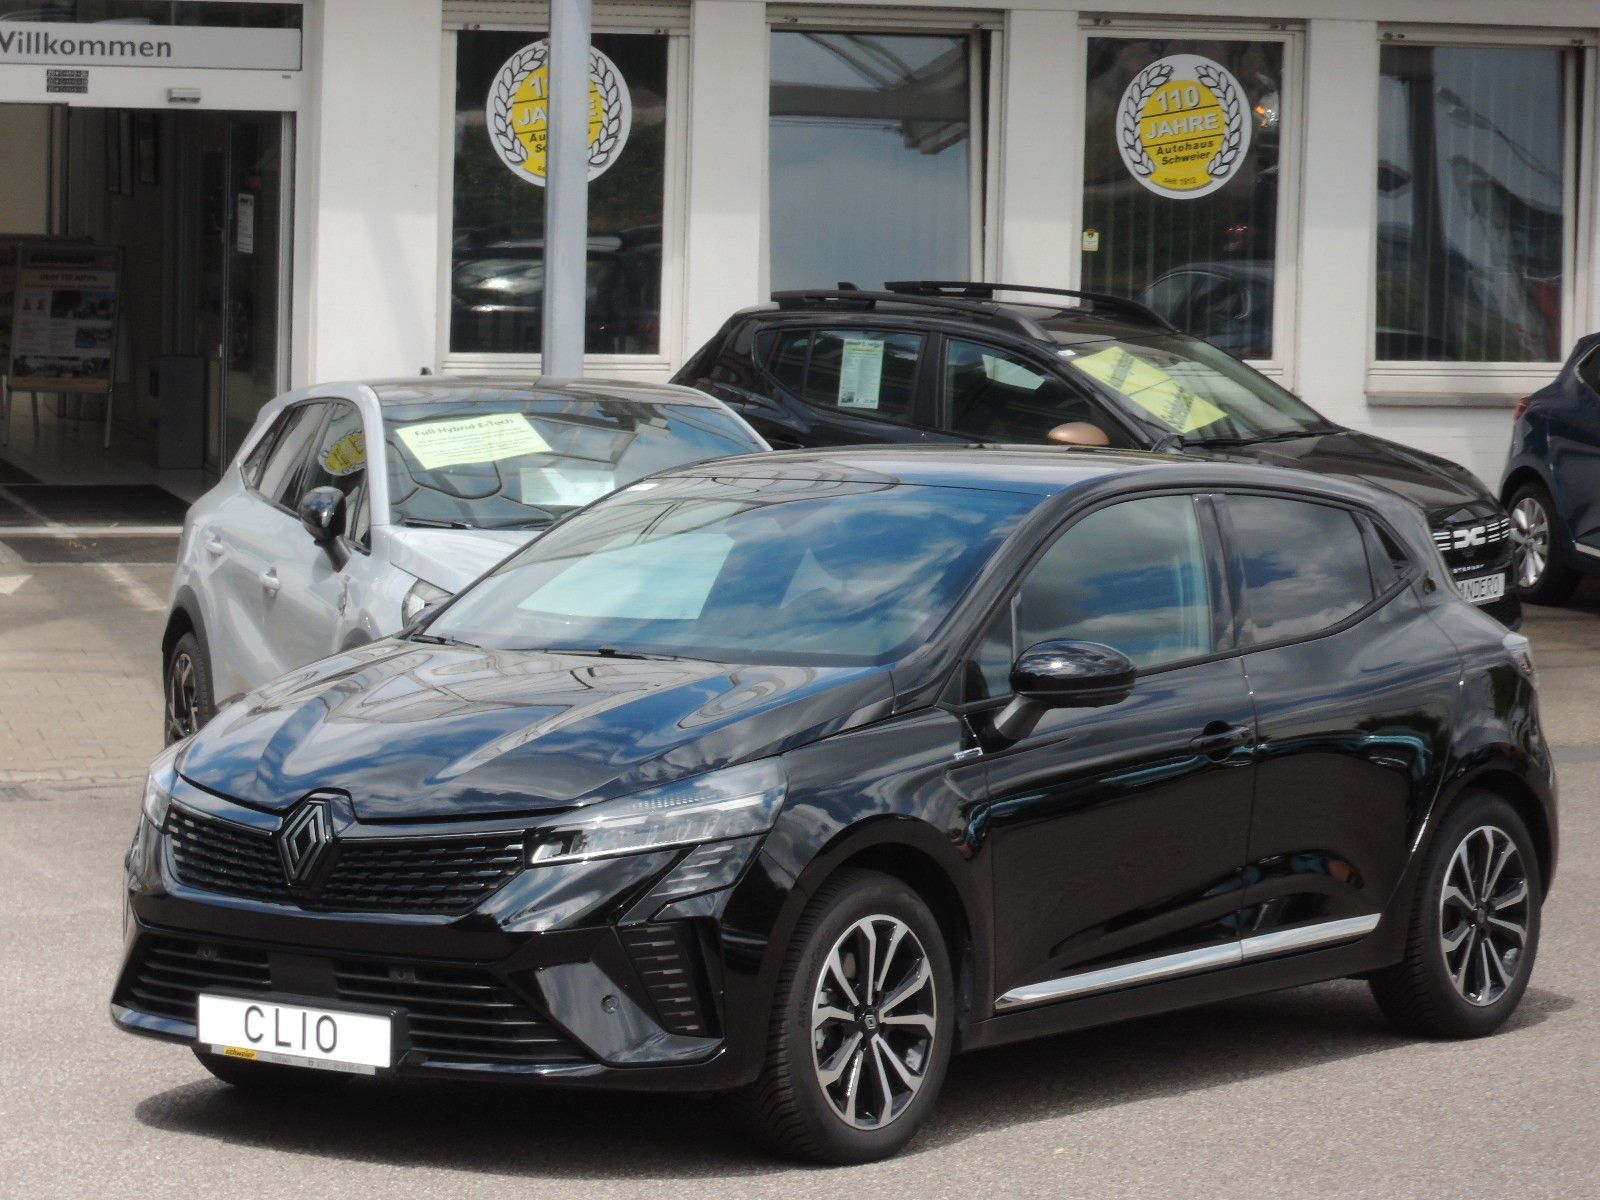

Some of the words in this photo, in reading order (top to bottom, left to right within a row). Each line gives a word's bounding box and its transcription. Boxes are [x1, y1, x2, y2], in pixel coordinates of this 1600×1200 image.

[1157, 86, 1200, 112] 110
[1147, 112, 1220, 139] JAHRE
[1156, 141, 1215, 155] Autohaus
[1161, 151, 1211, 165] Schweier
[414, 427, 436, 436] Full
[438, 423, 475, 433] Hybrid
[477, 418, 514, 428] E-Tech
[244, 1005, 338, 1053] CLIO
